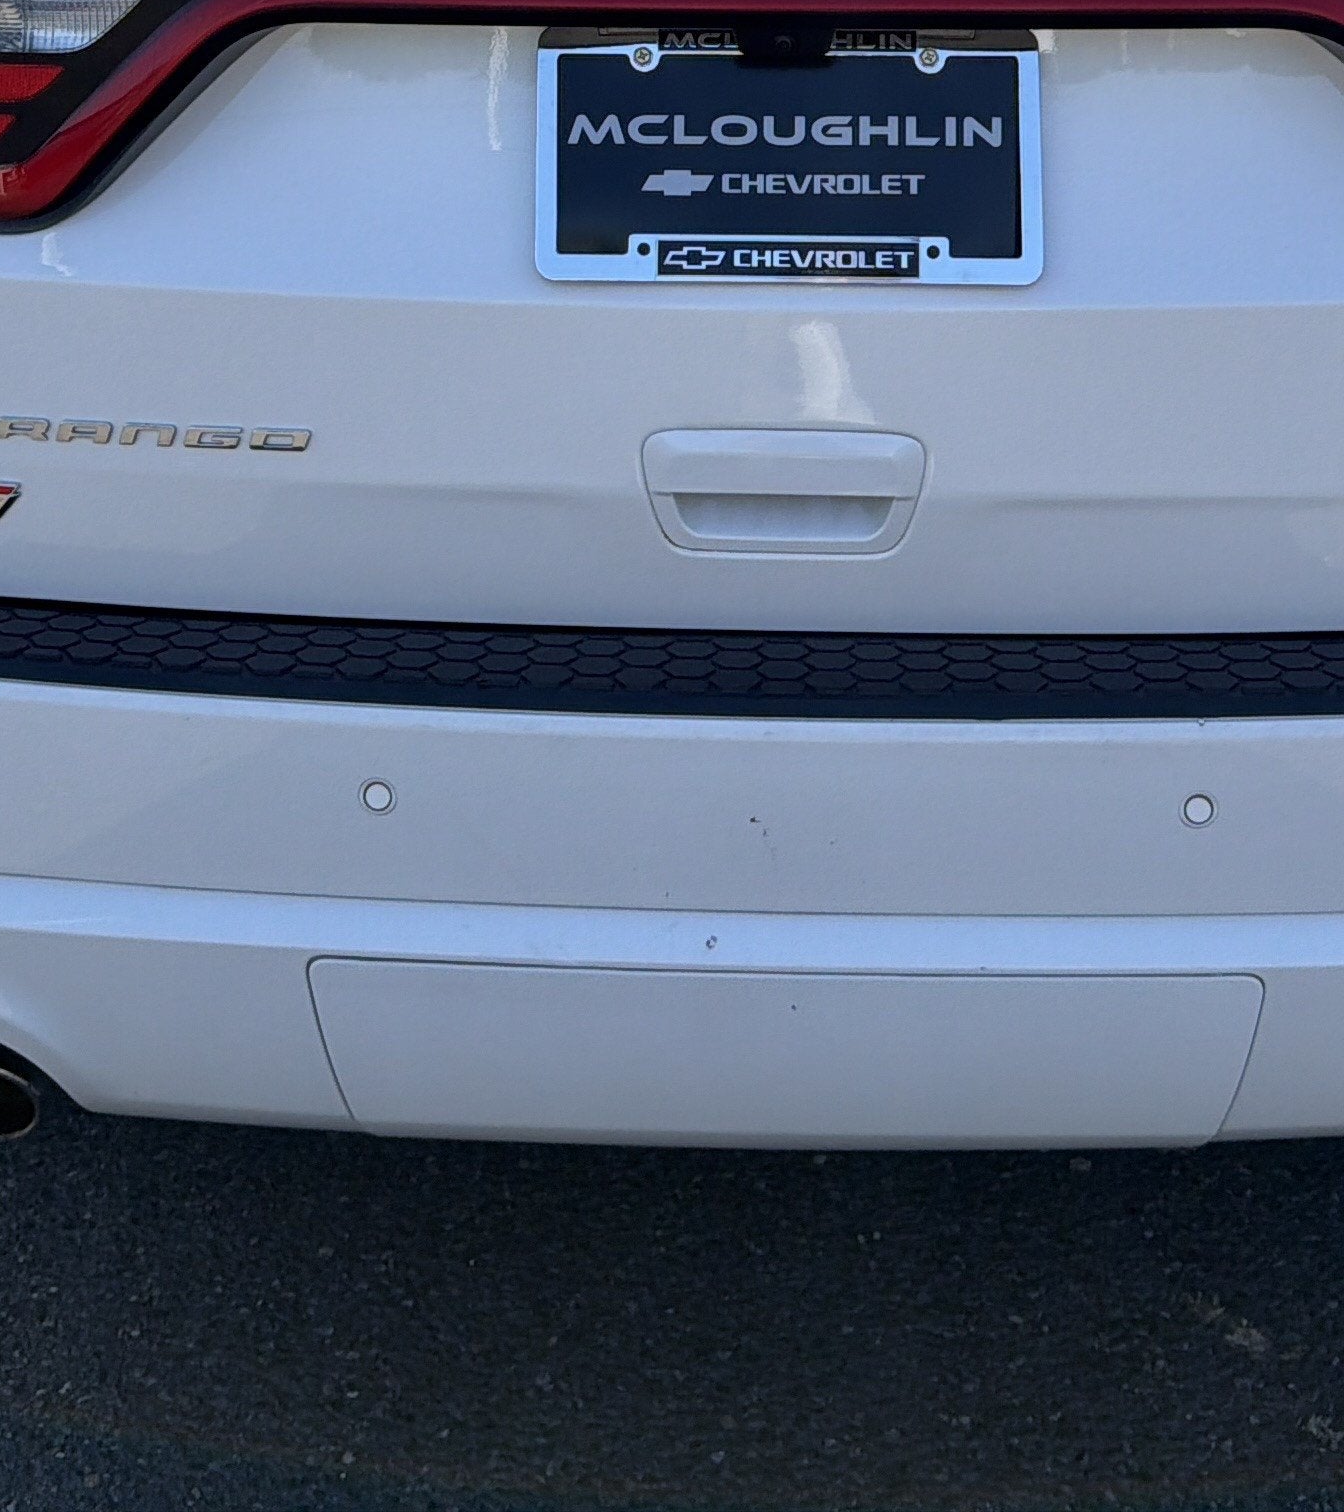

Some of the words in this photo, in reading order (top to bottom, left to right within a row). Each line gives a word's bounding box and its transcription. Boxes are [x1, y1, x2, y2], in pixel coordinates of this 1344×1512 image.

[662, 32, 913, 51] MCLHLIN
[567, 114, 1003, 148] MCLOUGHLIN
[722, 172, 925, 195] CHEVROLET
[733, 249, 915, 270] CHEVROLET
